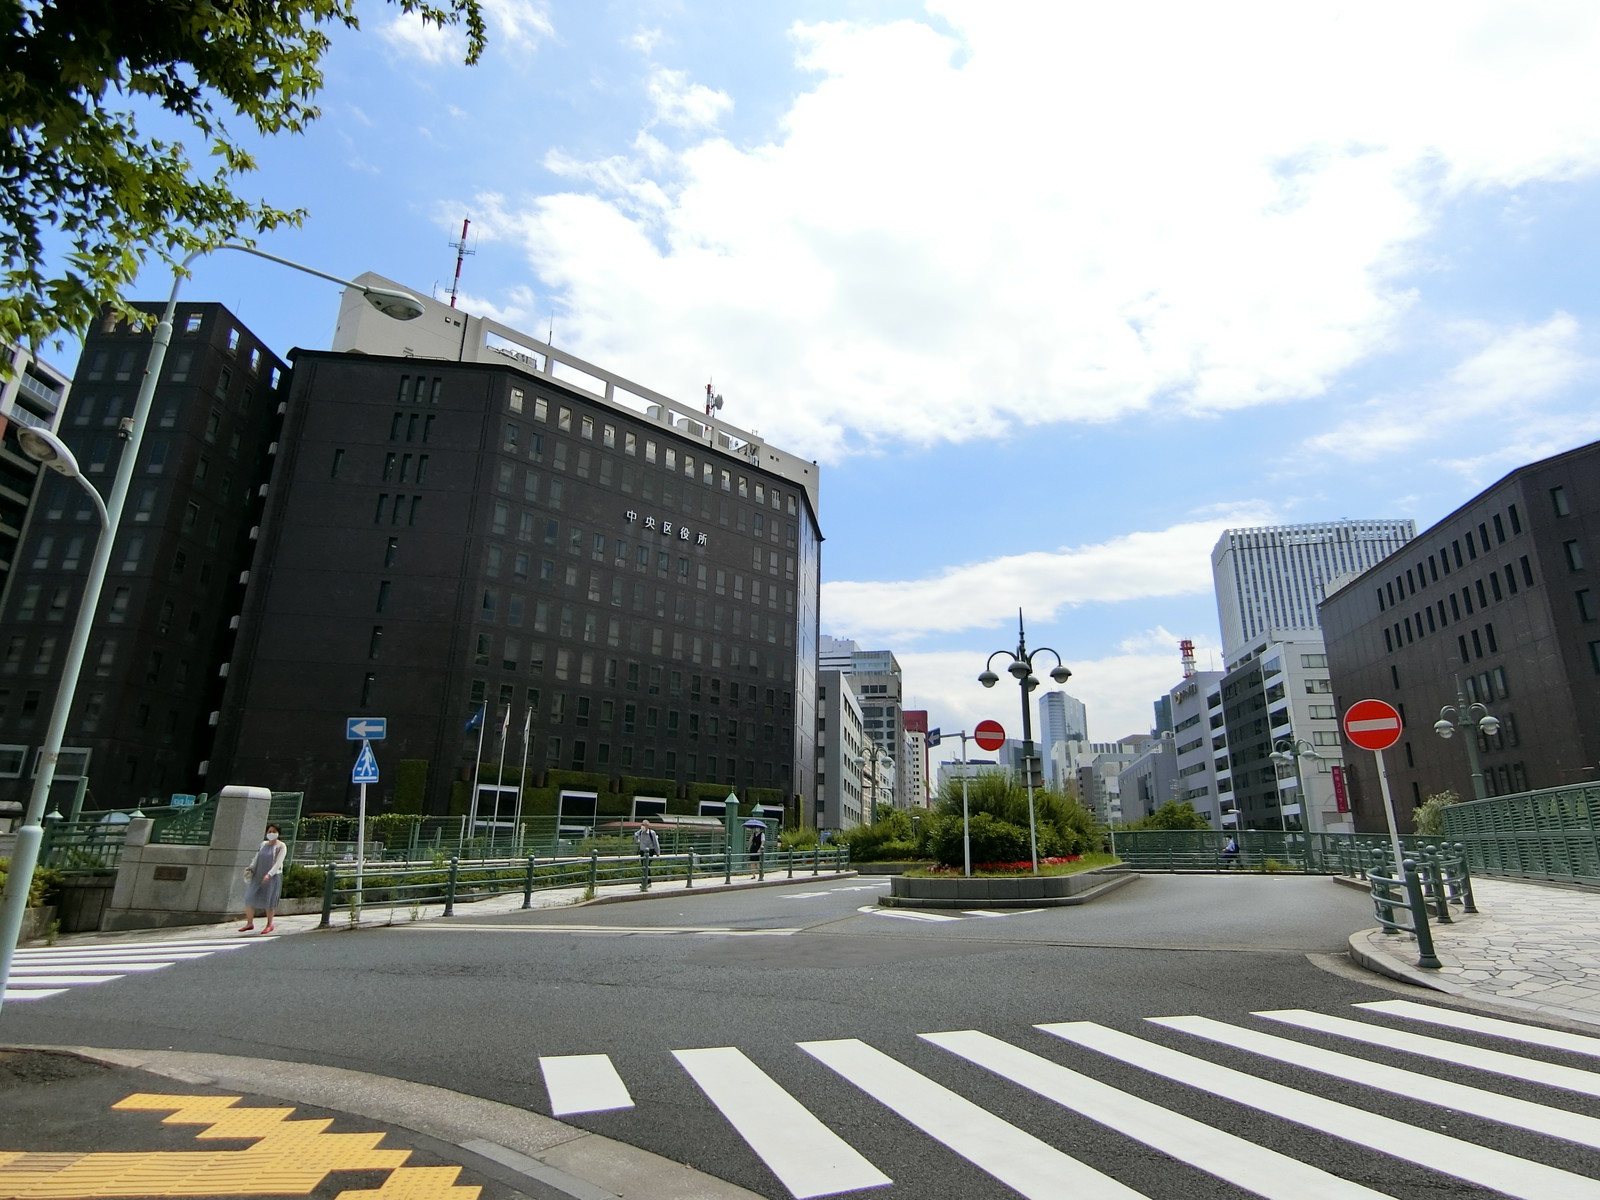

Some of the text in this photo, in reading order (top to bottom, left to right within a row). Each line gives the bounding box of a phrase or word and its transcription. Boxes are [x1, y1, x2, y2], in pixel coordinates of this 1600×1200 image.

[626, 510, 708, 546] 中央区役所
